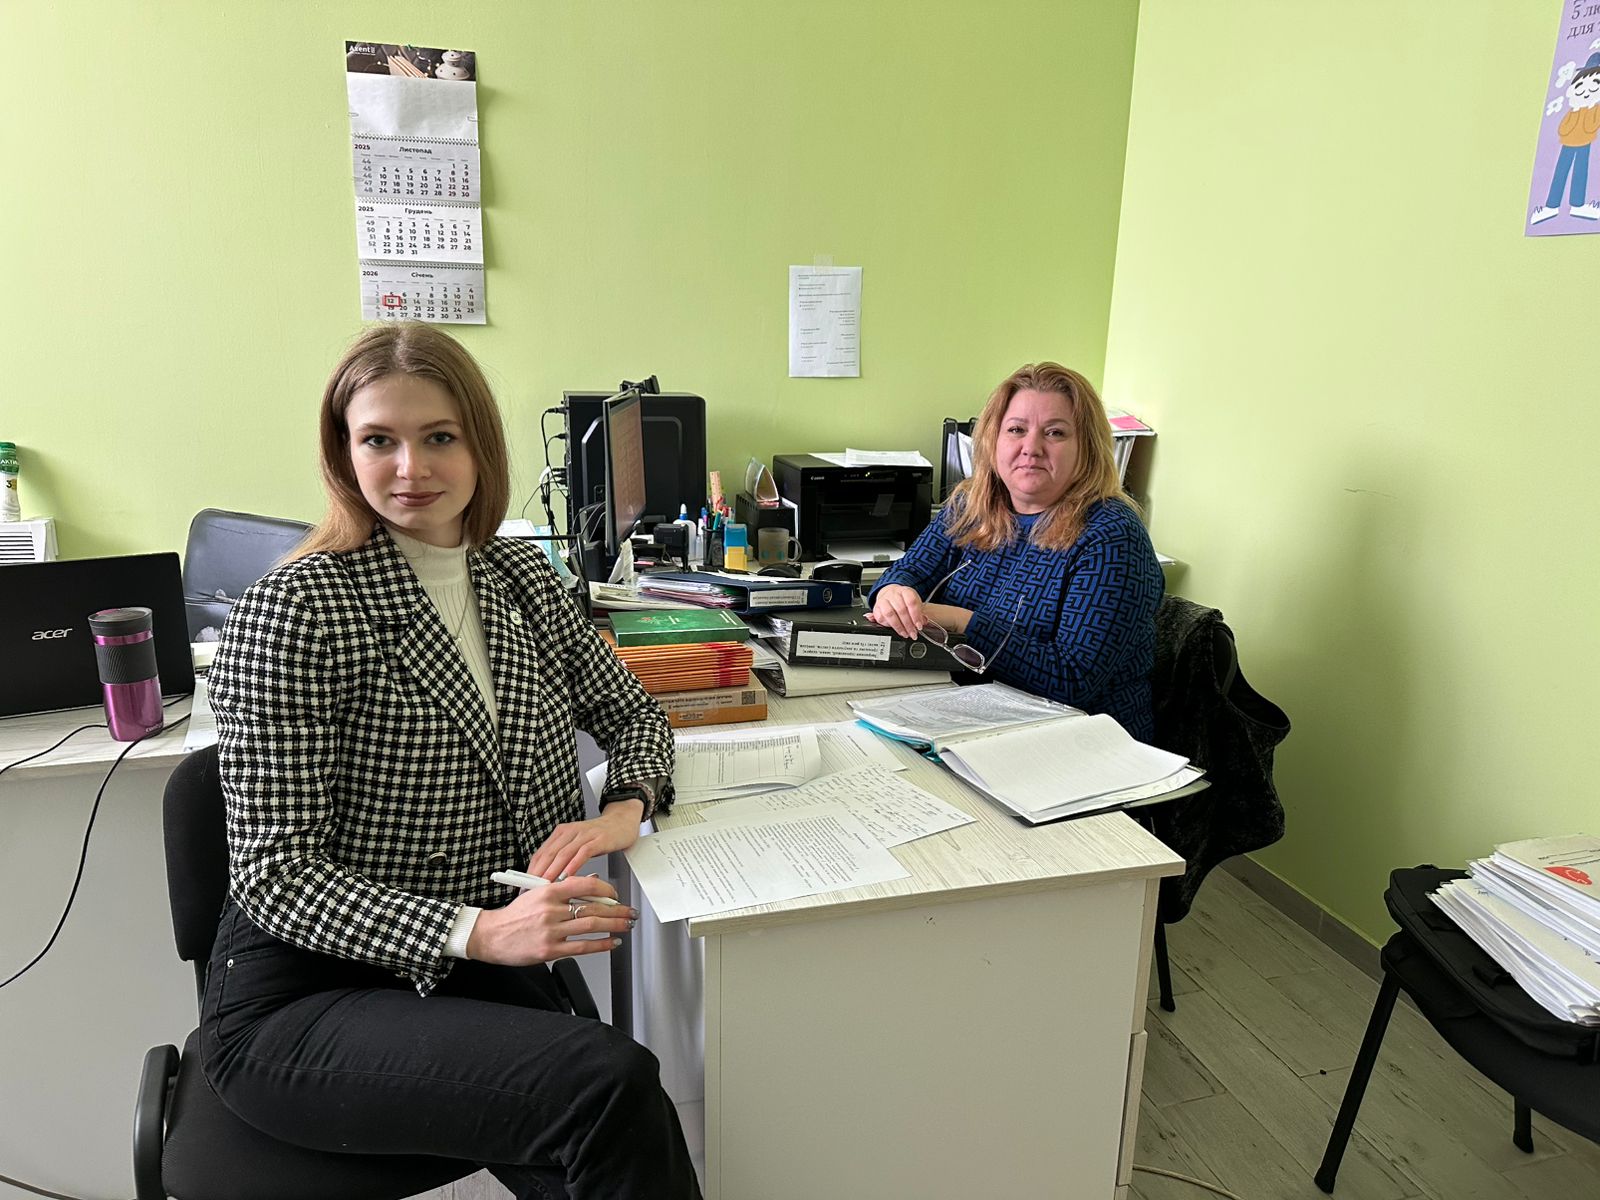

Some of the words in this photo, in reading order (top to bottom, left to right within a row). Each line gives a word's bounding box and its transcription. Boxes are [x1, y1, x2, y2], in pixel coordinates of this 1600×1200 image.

[1571, 4, 1581, 20] 5
[1567, 23, 1595, 40] для
[349, 45, 371, 53] Axent
[31, 627, 73, 641] acer
